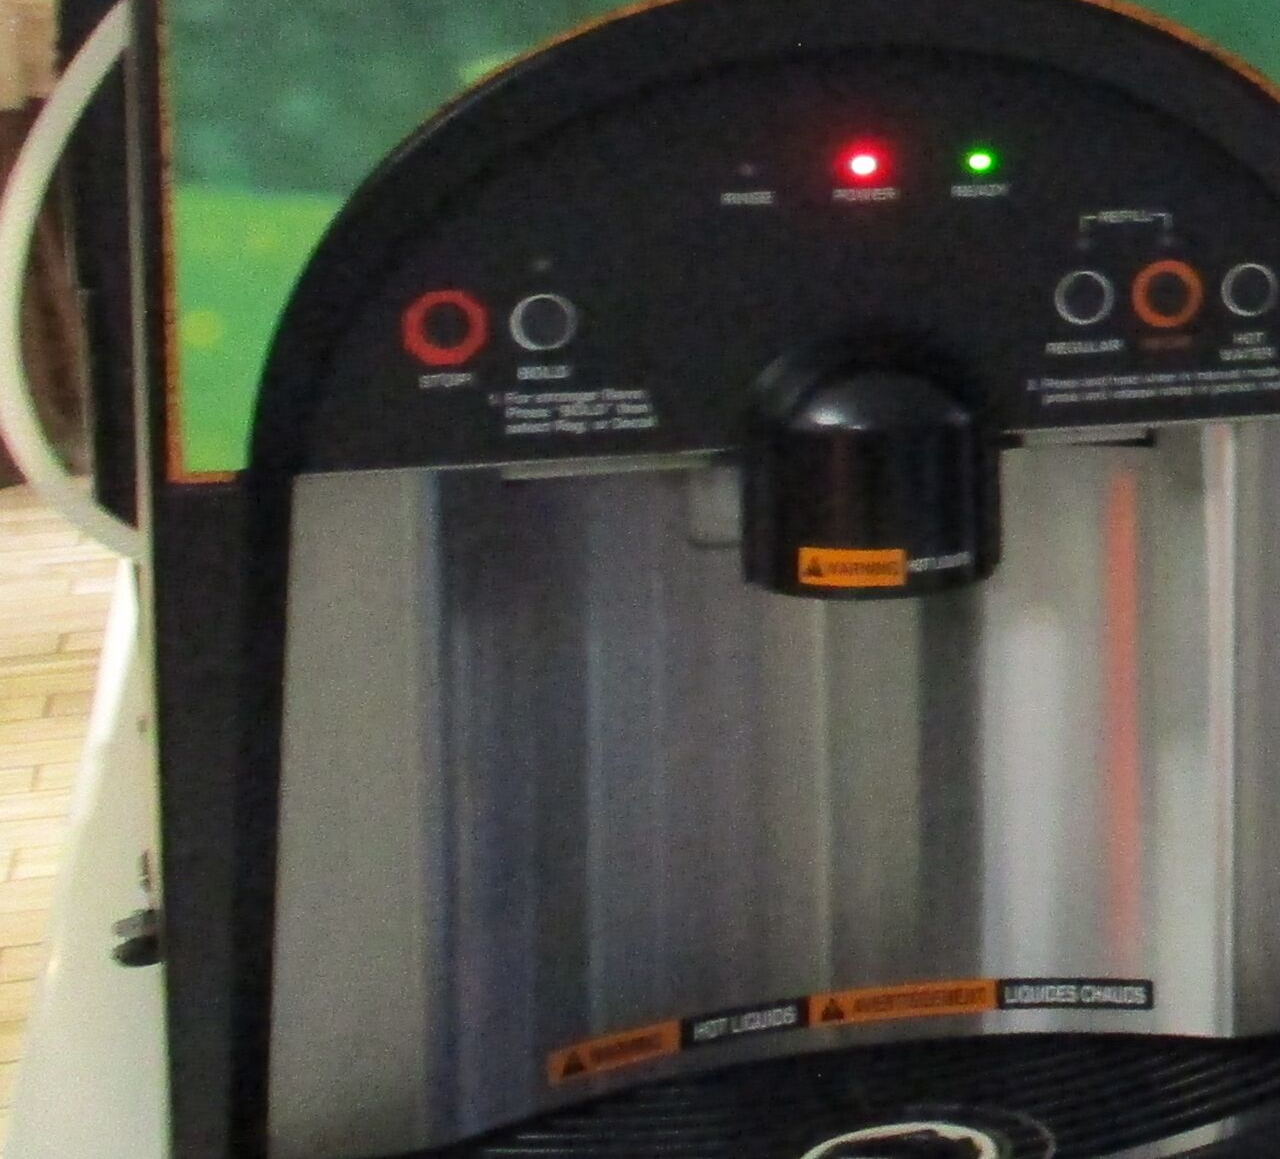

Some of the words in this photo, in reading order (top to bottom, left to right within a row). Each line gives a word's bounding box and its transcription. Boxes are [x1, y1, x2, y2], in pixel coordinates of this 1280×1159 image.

[833, 187, 898, 201] POWER
[950, 184, 1009, 198] READY
[1232, 332, 1267, 344] HOT
[1045, 340, 1126, 355] REGULAR
[418, 373, 475, 389] STOP
[1080, 985, 1148, 1004] CHAUDS
[731, 1004, 798, 1033] LIQUIDS
